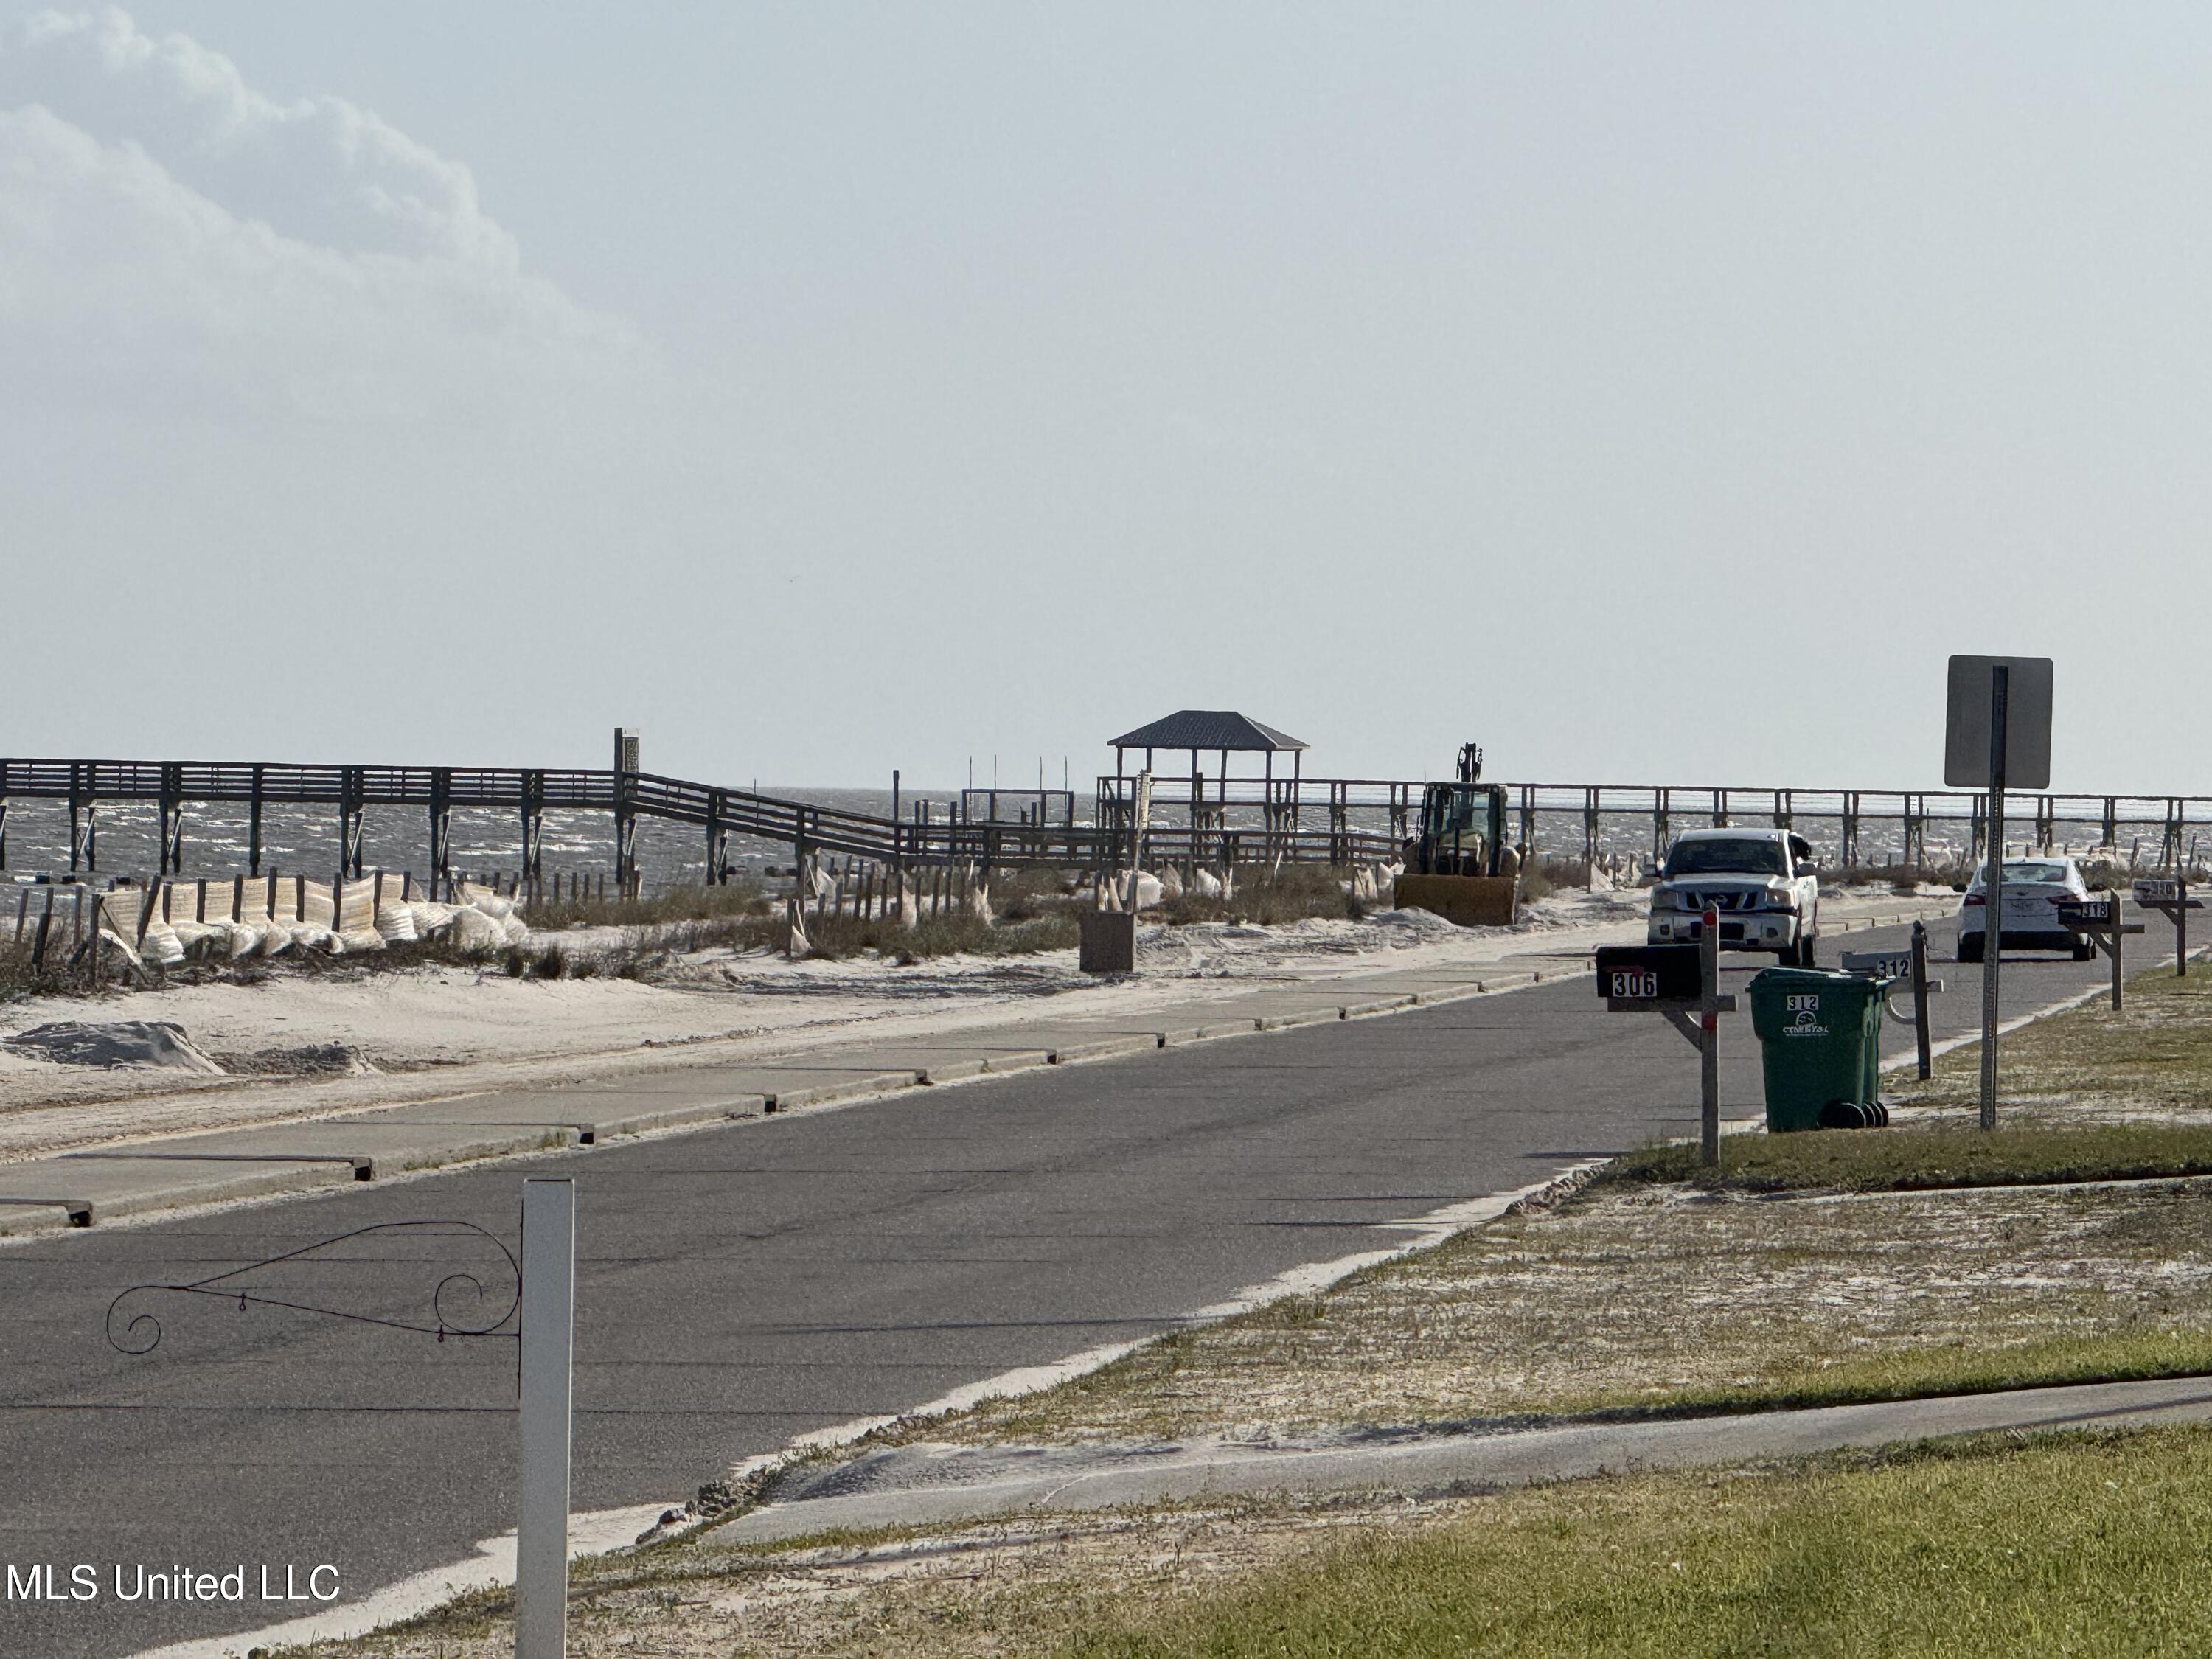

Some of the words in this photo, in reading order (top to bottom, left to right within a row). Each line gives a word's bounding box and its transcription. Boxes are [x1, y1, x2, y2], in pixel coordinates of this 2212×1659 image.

[1879, 959, 1909, 978] 312
[1615, 973, 1655, 996] 306
[1789, 996, 1817, 1009] 312
